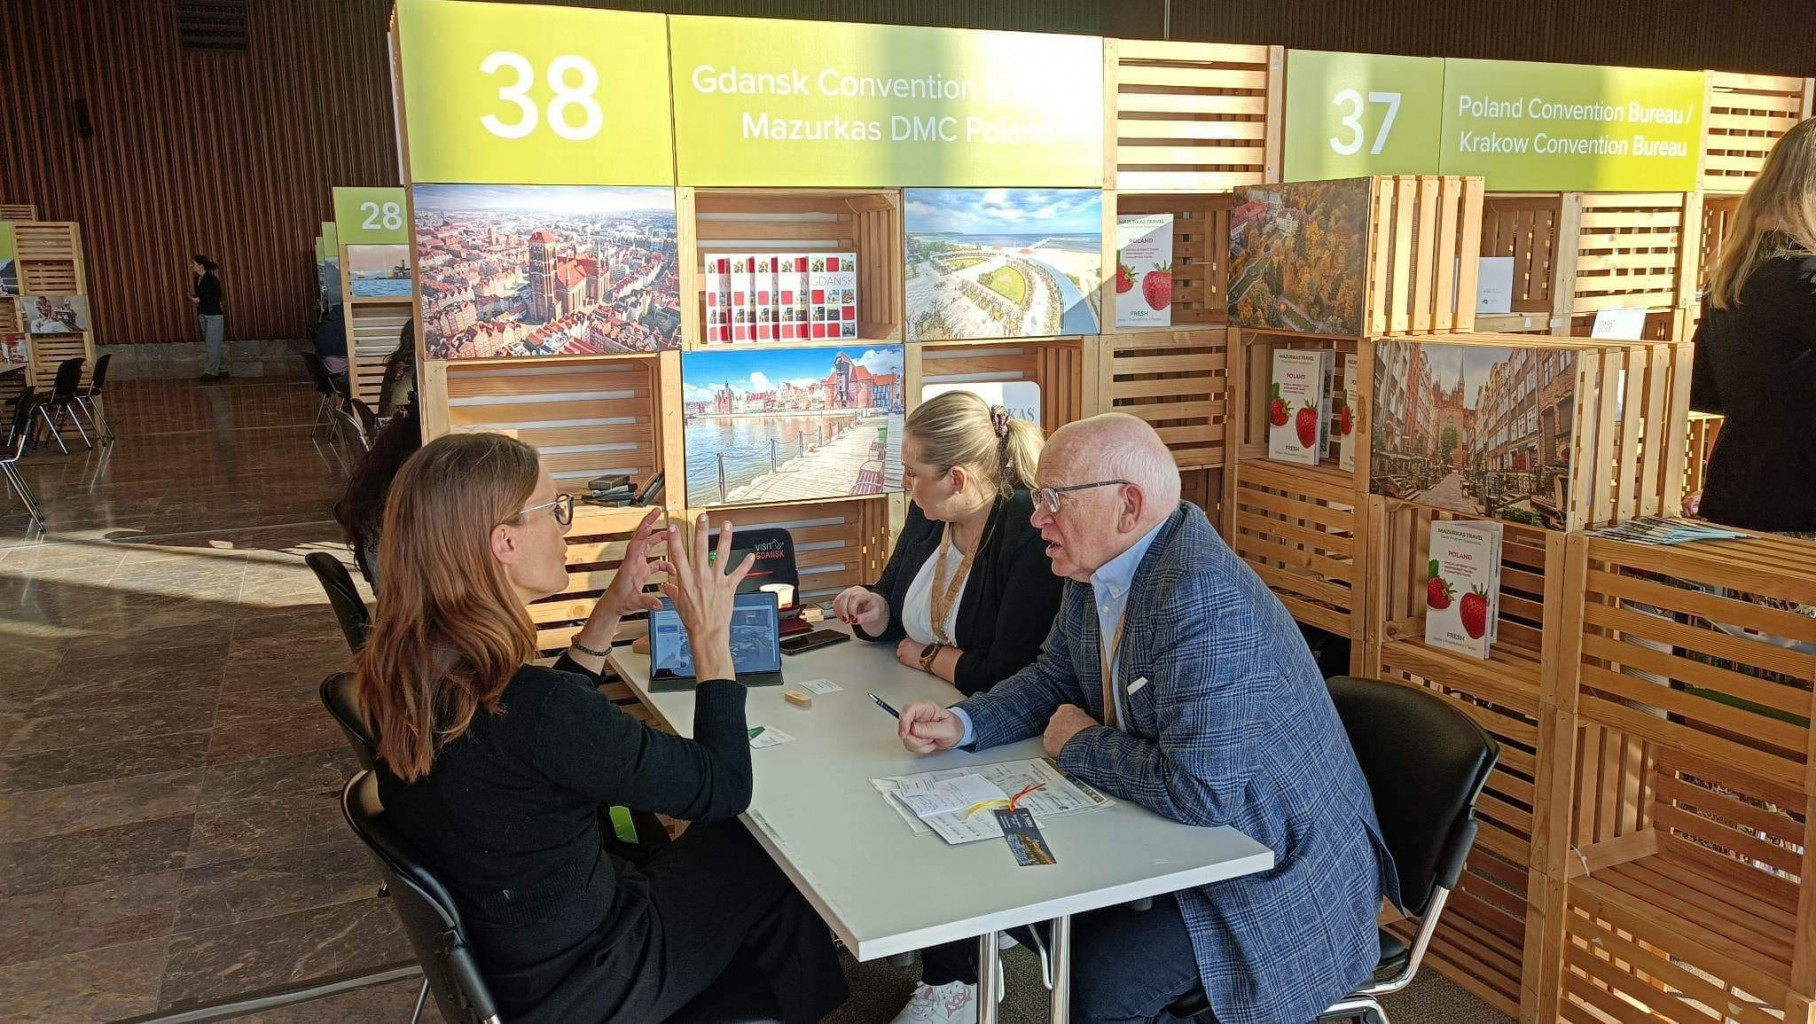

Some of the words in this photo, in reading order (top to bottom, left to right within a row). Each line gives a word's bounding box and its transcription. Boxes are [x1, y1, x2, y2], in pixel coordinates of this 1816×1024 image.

[479, 51, 602, 141] 38
[692, 65, 809, 96] Gdansk
[818, 69, 977, 100] Convention
[1329, 89, 1402, 157] 37
[1458, 95, 1523, 119] Poland
[1528, 97, 1624, 122] Convention
[1628, 101, 1684, 125] Bureau
[742, 112, 882, 141] Mazurkas
[891, 115, 958, 142] DMC
[966, 116, 1055, 144] Poland
[1459, 130, 1529, 153] Krakow
[1533, 132, 1628, 155] Convention
[1632, 135, 1688, 157] Bureau
[360, 202, 402, 230] 28
[811, 276, 854, 287] GDANSK
[1008, 407, 1035, 422] KAS
[754, 542, 773, 552] VISIT
[755, 550, 785, 560] GDANSK
[1448, 550, 1473, 560] POLAND
[1446, 631, 1465, 642] FRESH
